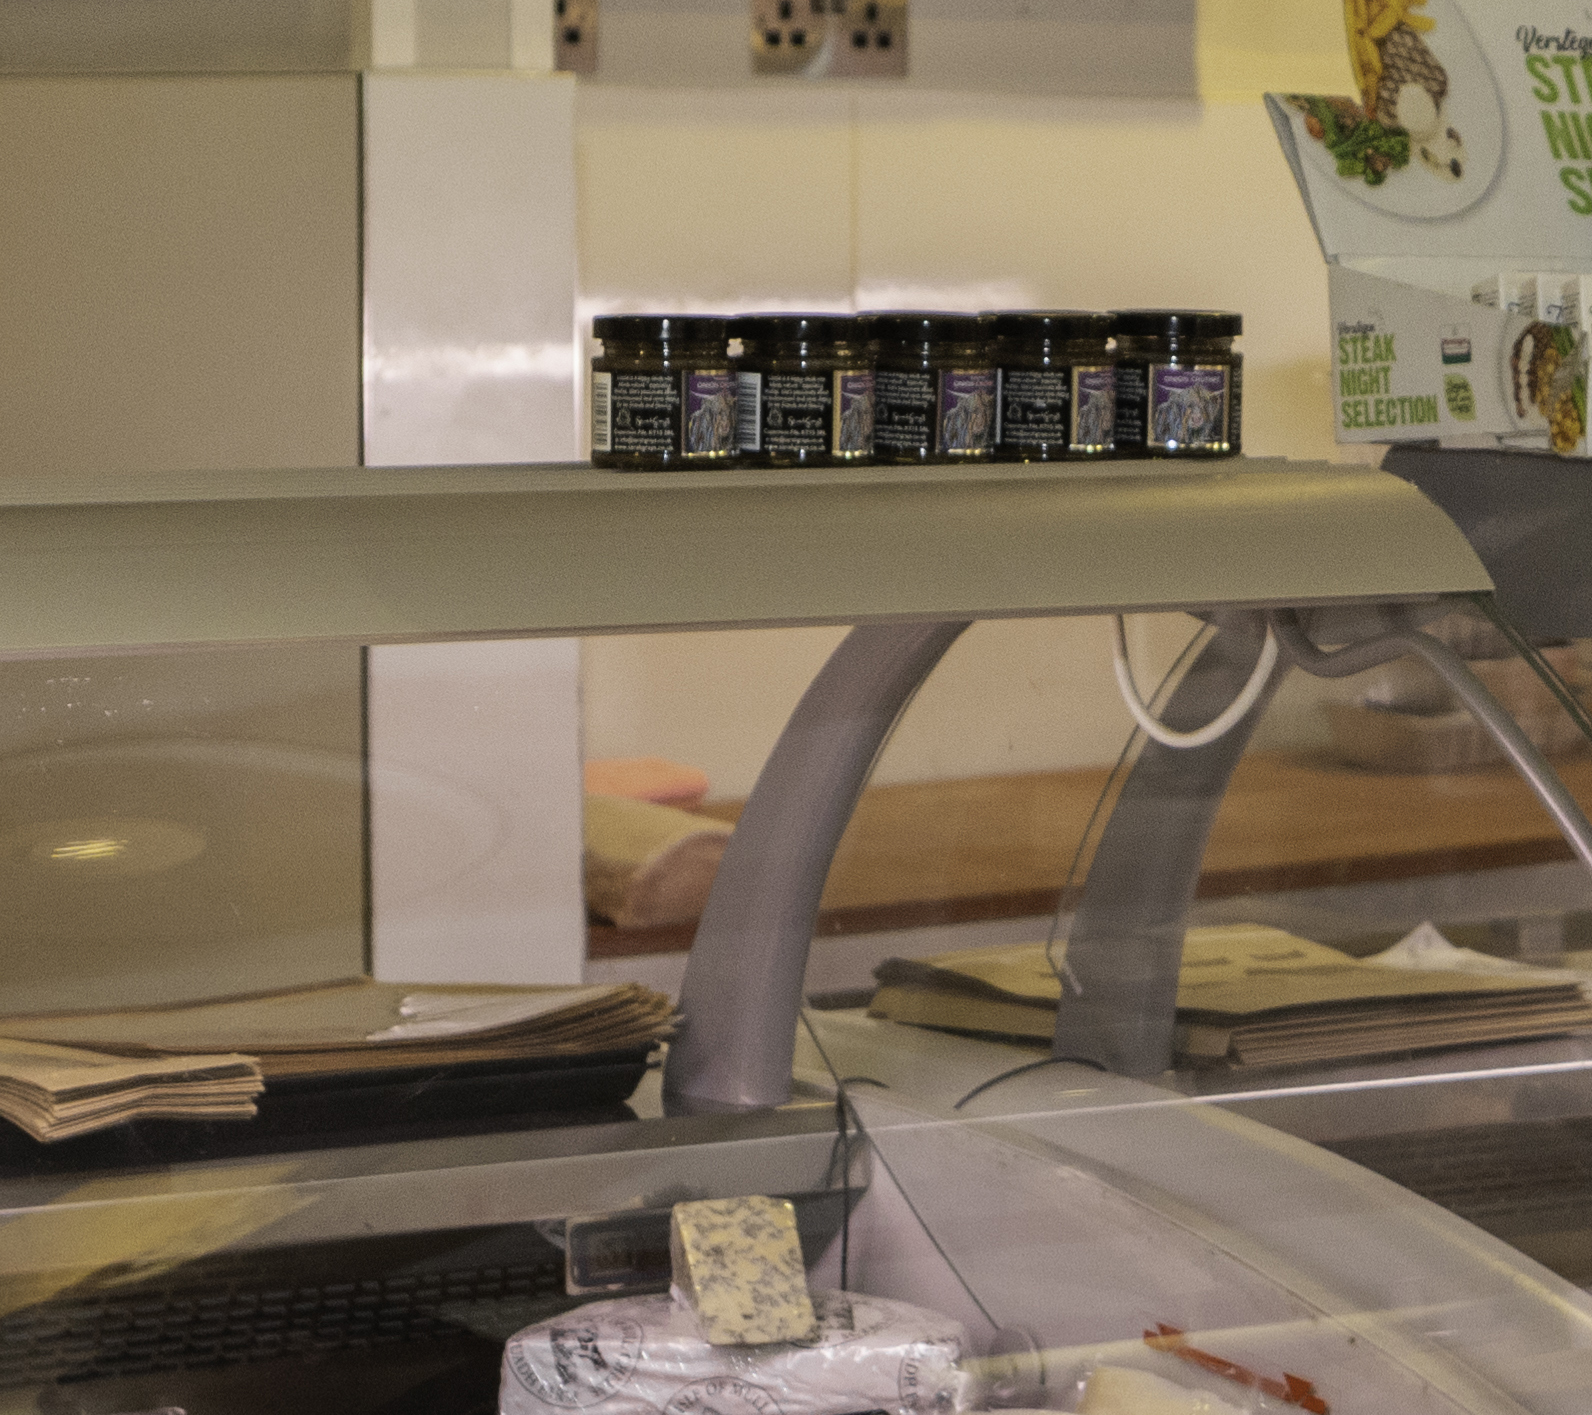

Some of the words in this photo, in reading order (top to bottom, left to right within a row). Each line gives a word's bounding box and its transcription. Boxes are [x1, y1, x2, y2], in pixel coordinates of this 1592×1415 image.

[1338, 333, 1396, 364] STEAK
[1339, 365, 1391, 397] NIGHT
[1341, 393, 1440, 429] SELECTION
